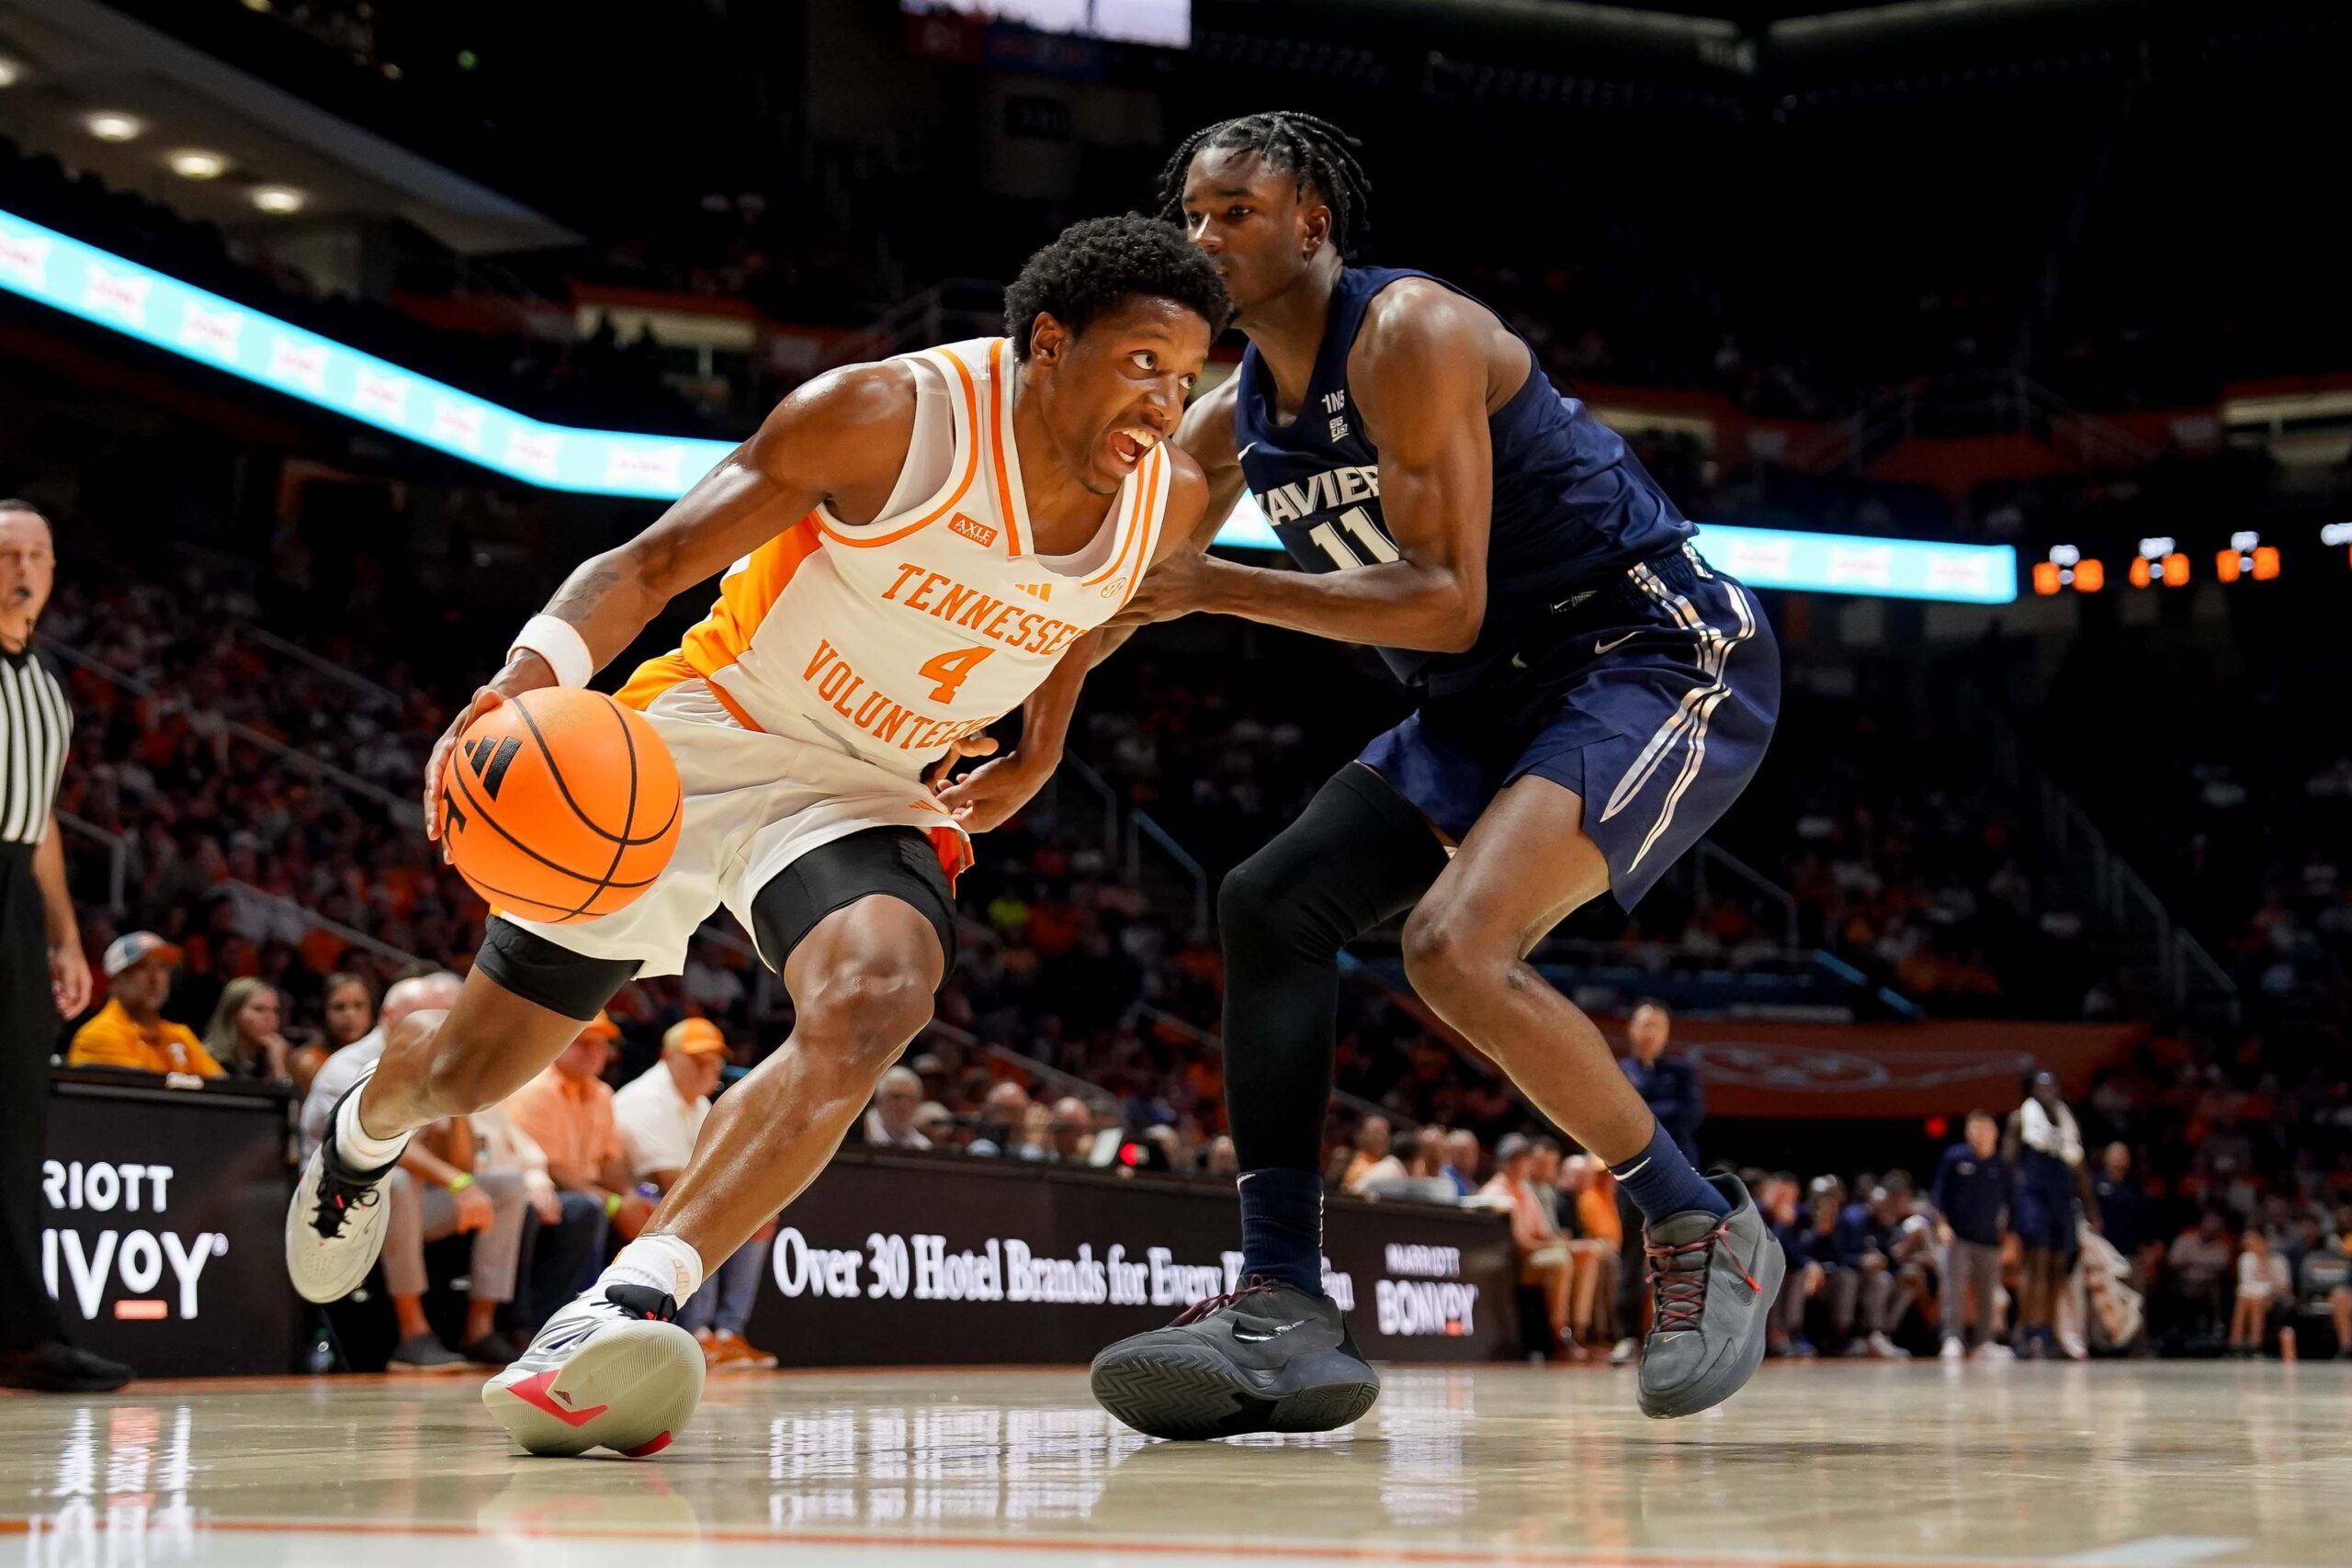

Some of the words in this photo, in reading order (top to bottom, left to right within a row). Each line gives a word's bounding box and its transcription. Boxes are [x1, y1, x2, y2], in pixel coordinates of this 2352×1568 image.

[1331, 423, 1349, 437] EAST
[954, 518, 992, 539] AXLE
[1309, 506, 1399, 570] 11
[919, 646, 996, 705] 4
[773, 1227, 863, 1297] Over
[866, 1233, 910, 1299] 30
[910, 1234, 1004, 1301] Hotel
[1004, 1238, 1108, 1304] Brands
[1108, 1244, 1148, 1305] for
